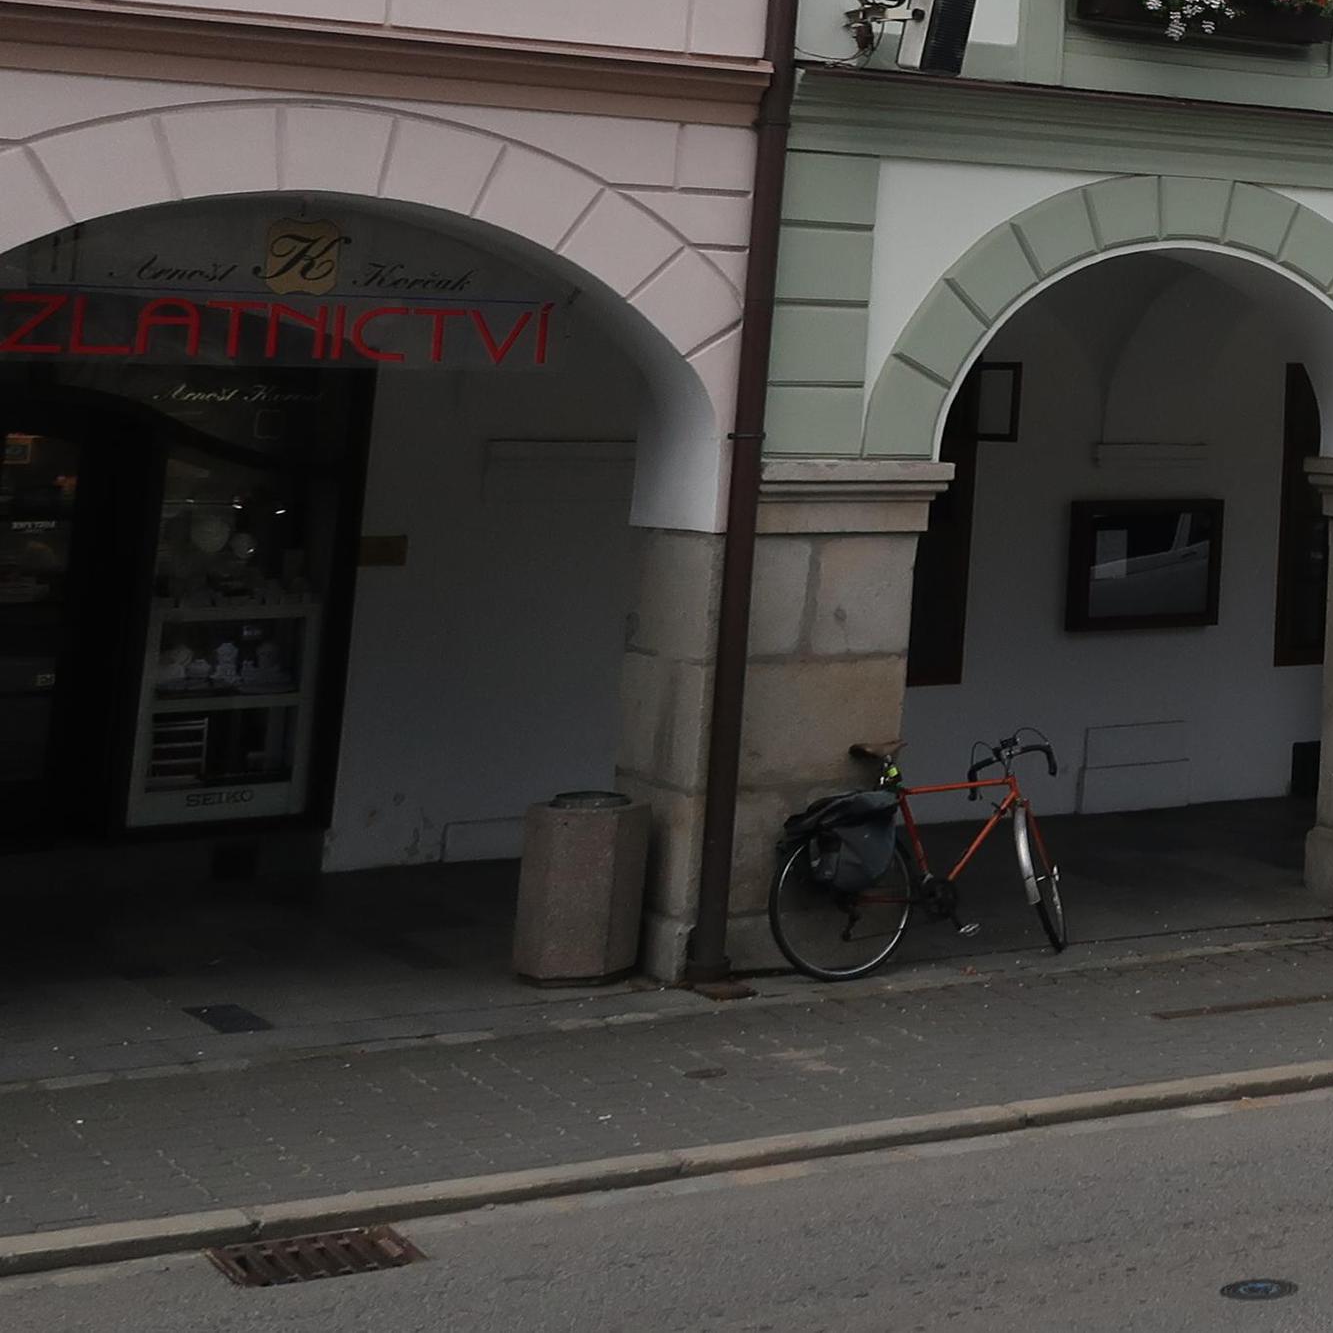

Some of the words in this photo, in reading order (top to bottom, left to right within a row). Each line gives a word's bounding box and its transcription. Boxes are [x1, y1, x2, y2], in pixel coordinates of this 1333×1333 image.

[108, 254, 236, 282] Arnošt
[352, 262, 475, 293] Korčak
[0, 291, 556, 366] ZLATNICTVÍ
[185, 789, 255, 808] SEIKO
